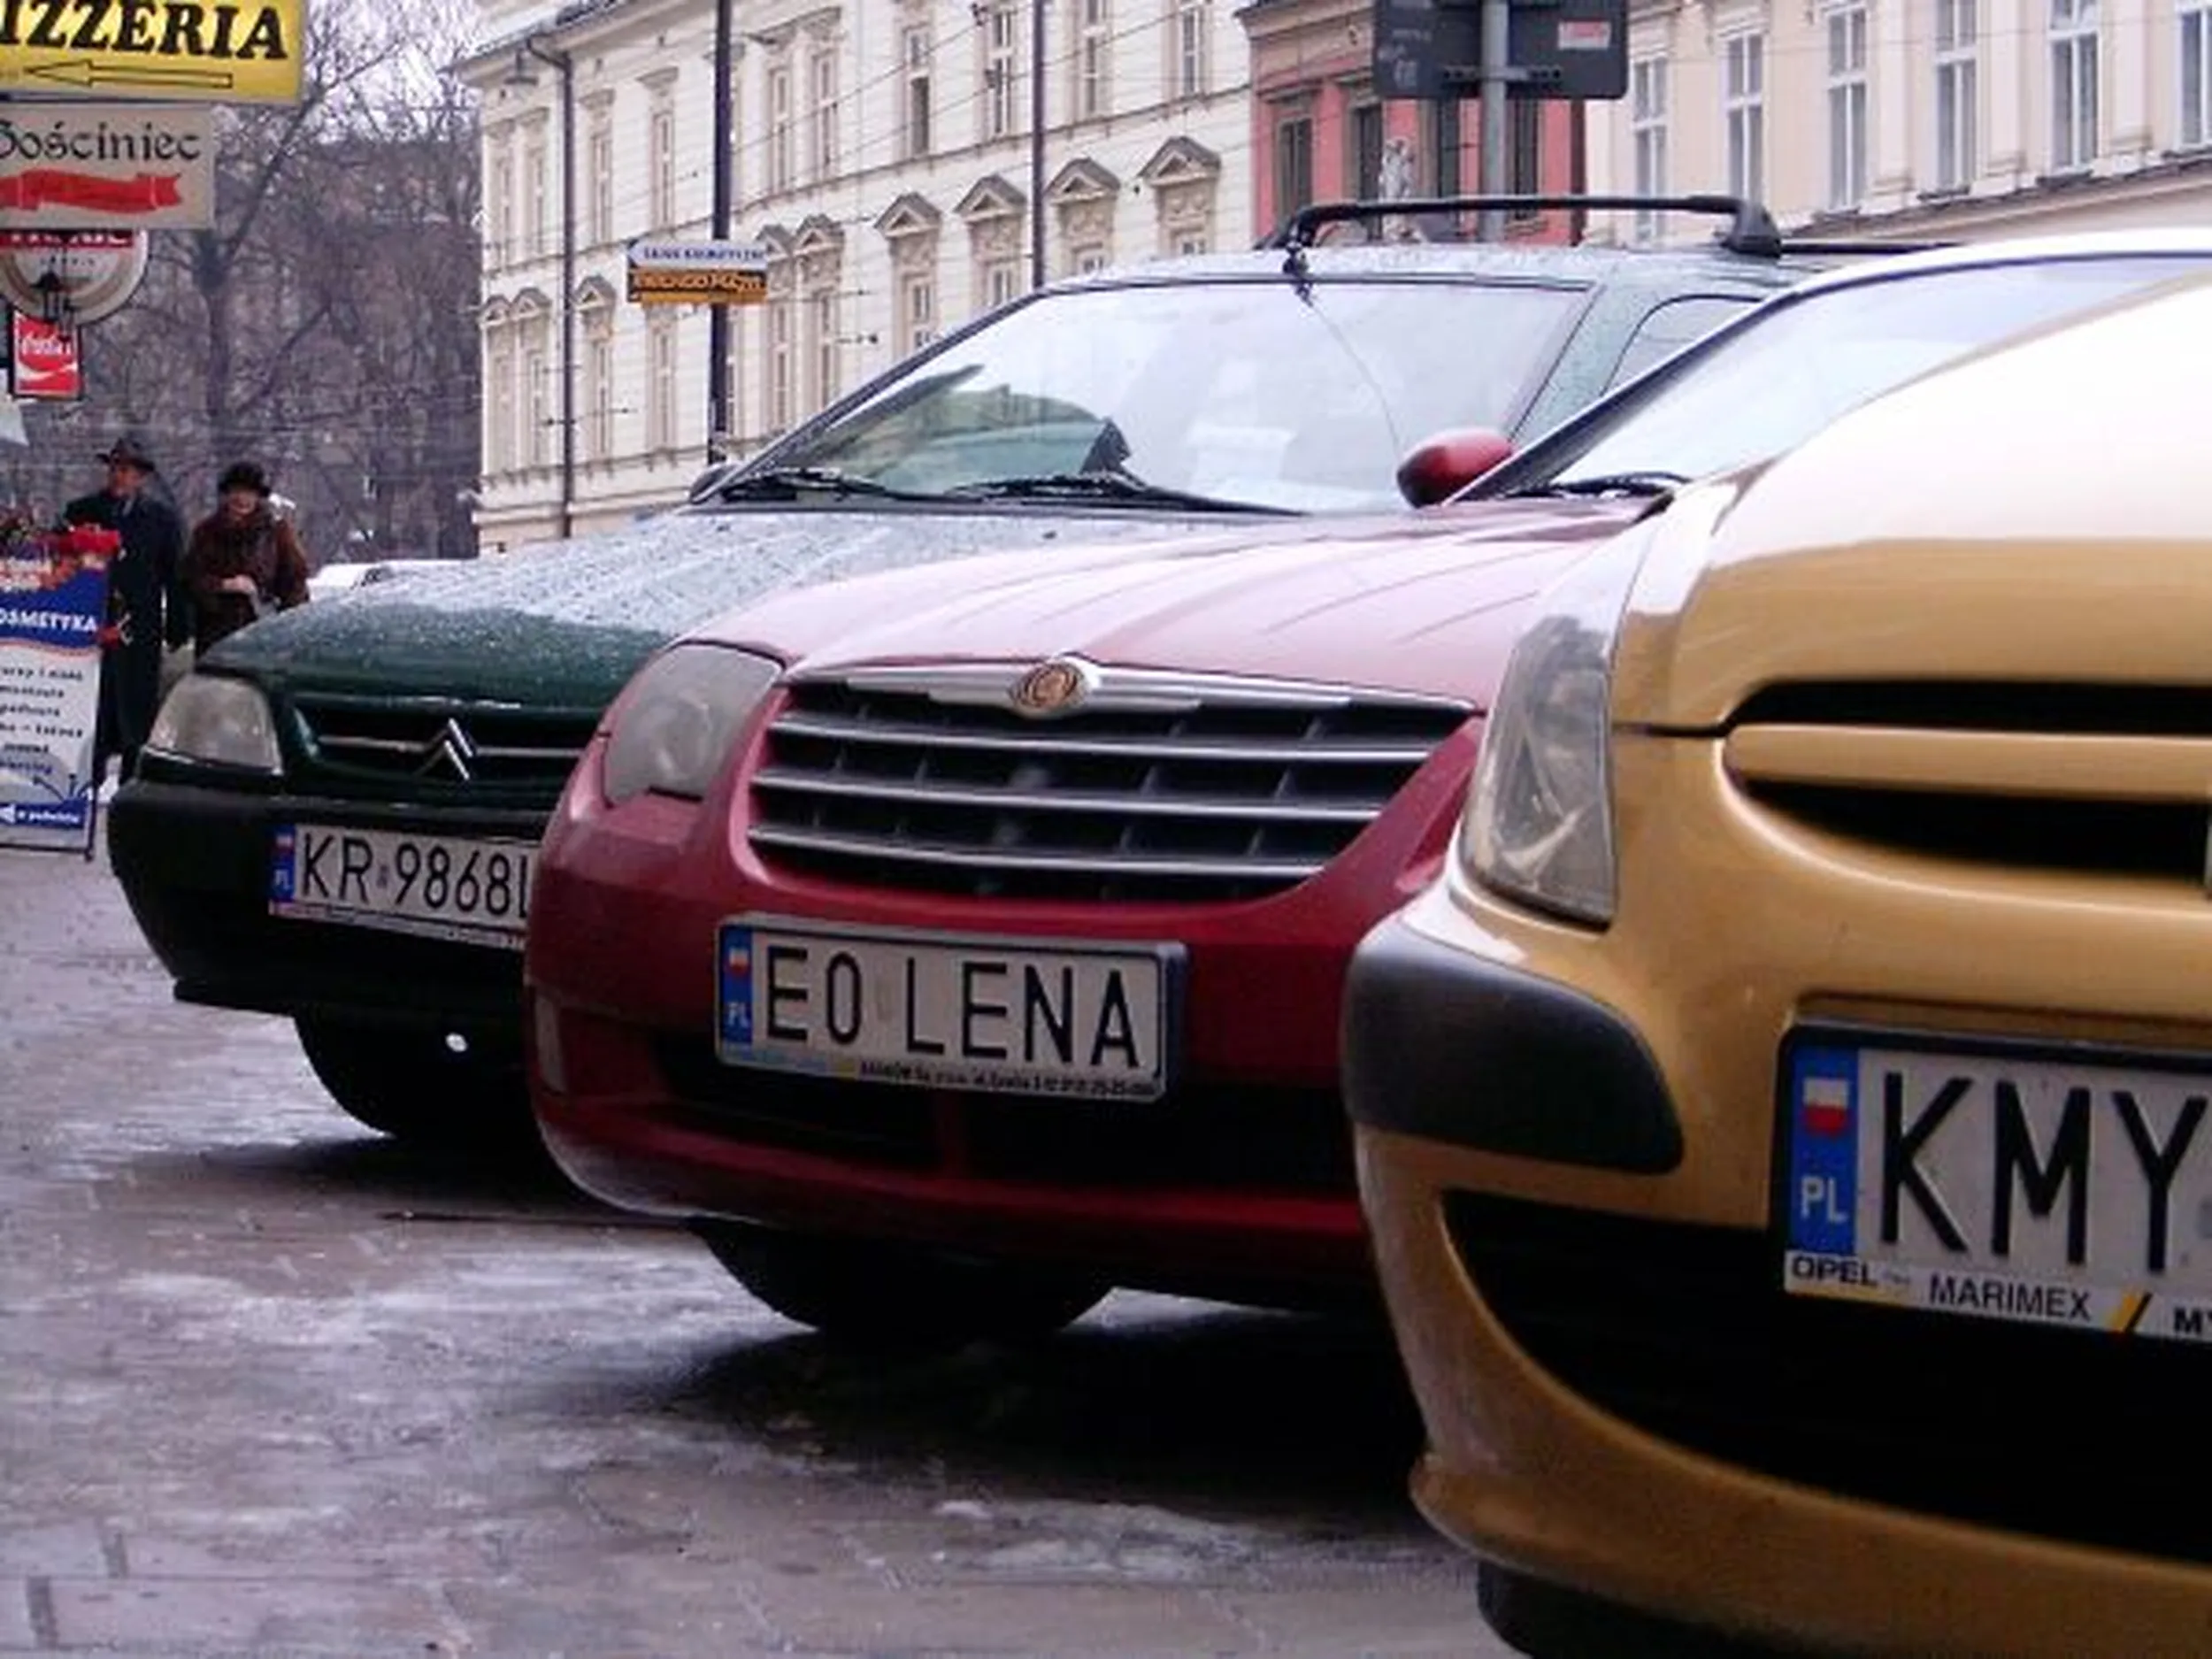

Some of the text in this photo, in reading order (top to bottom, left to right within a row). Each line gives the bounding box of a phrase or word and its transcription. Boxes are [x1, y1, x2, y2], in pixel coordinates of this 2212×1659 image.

[301, 833, 370, 904] KR
[727, 1002, 749, 1027] PL
[905, 956, 1140, 1068] LENA
[1800, 1175, 1847, 1223] PL
[1879, 1071, 2209, 1275] KMY
[1791, 1255, 1878, 1287] OPEL
[1929, 1272, 2092, 1322] MARIMEX
